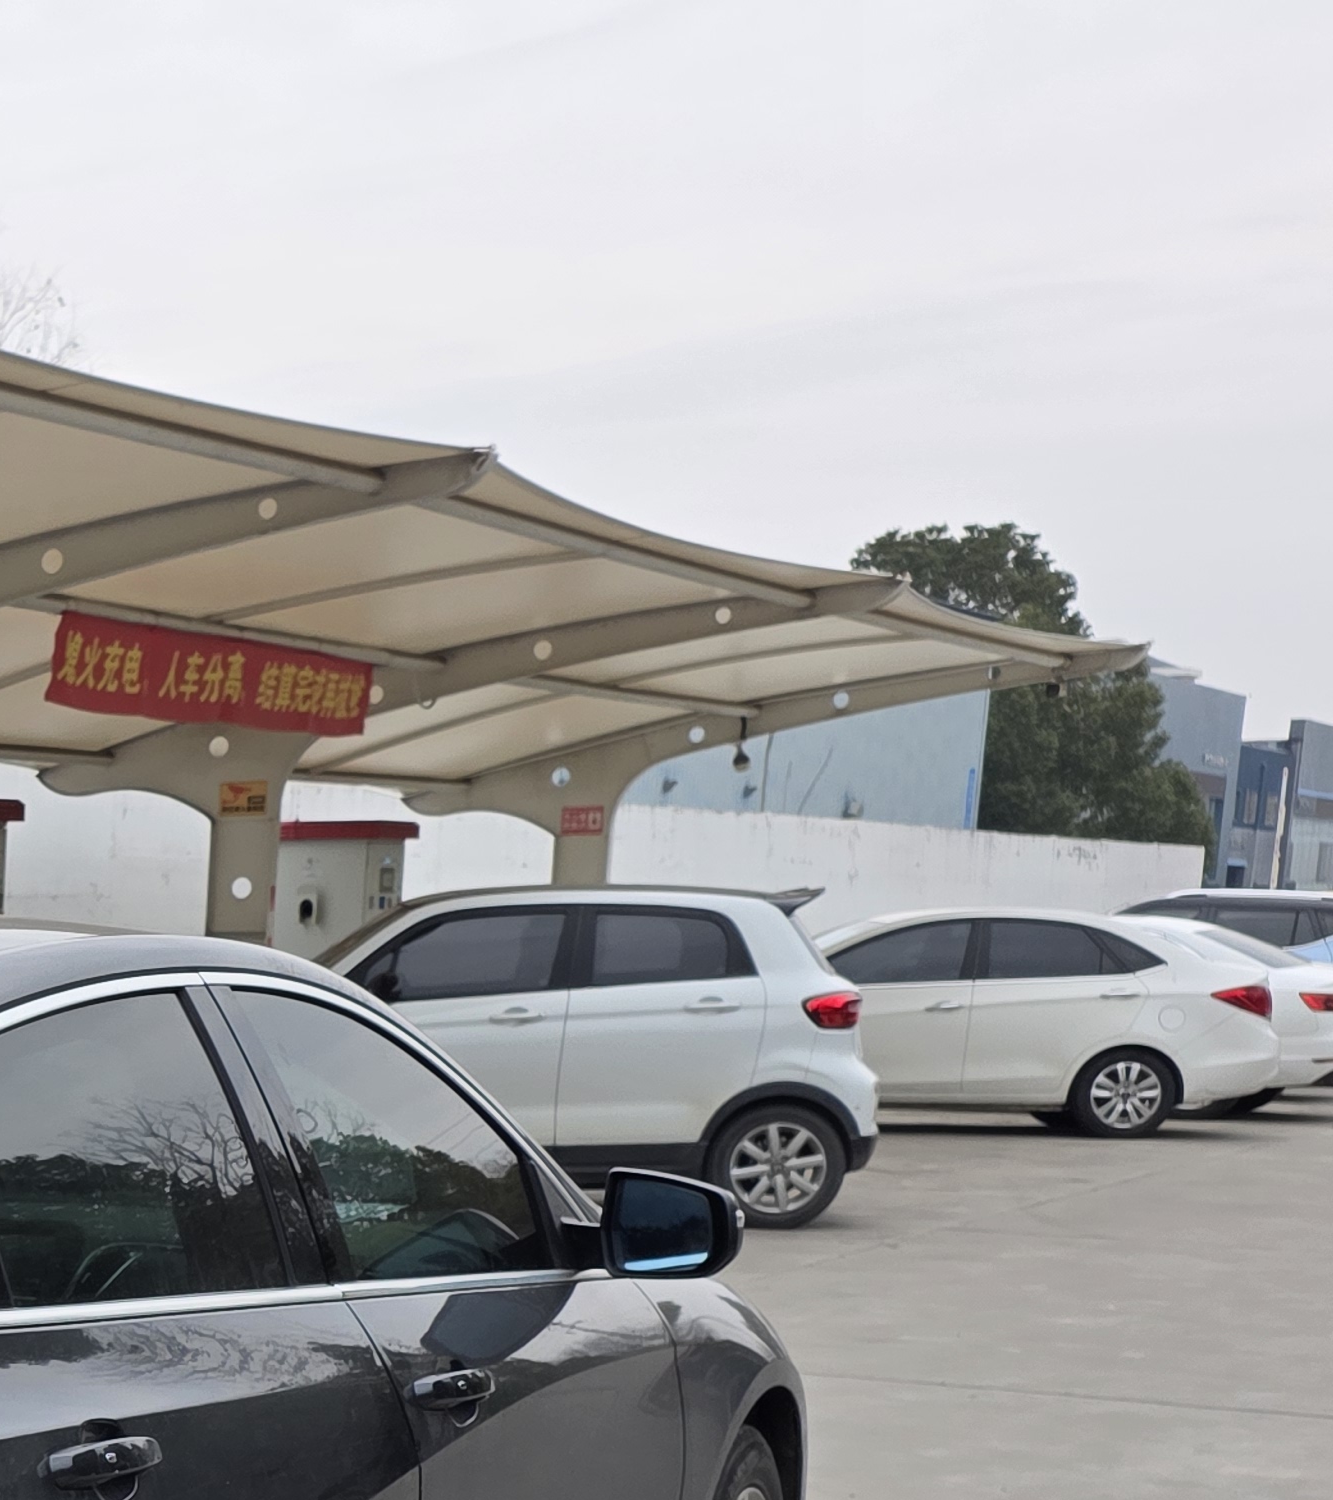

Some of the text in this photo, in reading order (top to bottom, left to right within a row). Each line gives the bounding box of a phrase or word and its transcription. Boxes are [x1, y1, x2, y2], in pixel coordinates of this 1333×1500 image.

[57, 630, 143, 694] 熄火充电
[158, 650, 246, 703] 人车分离
